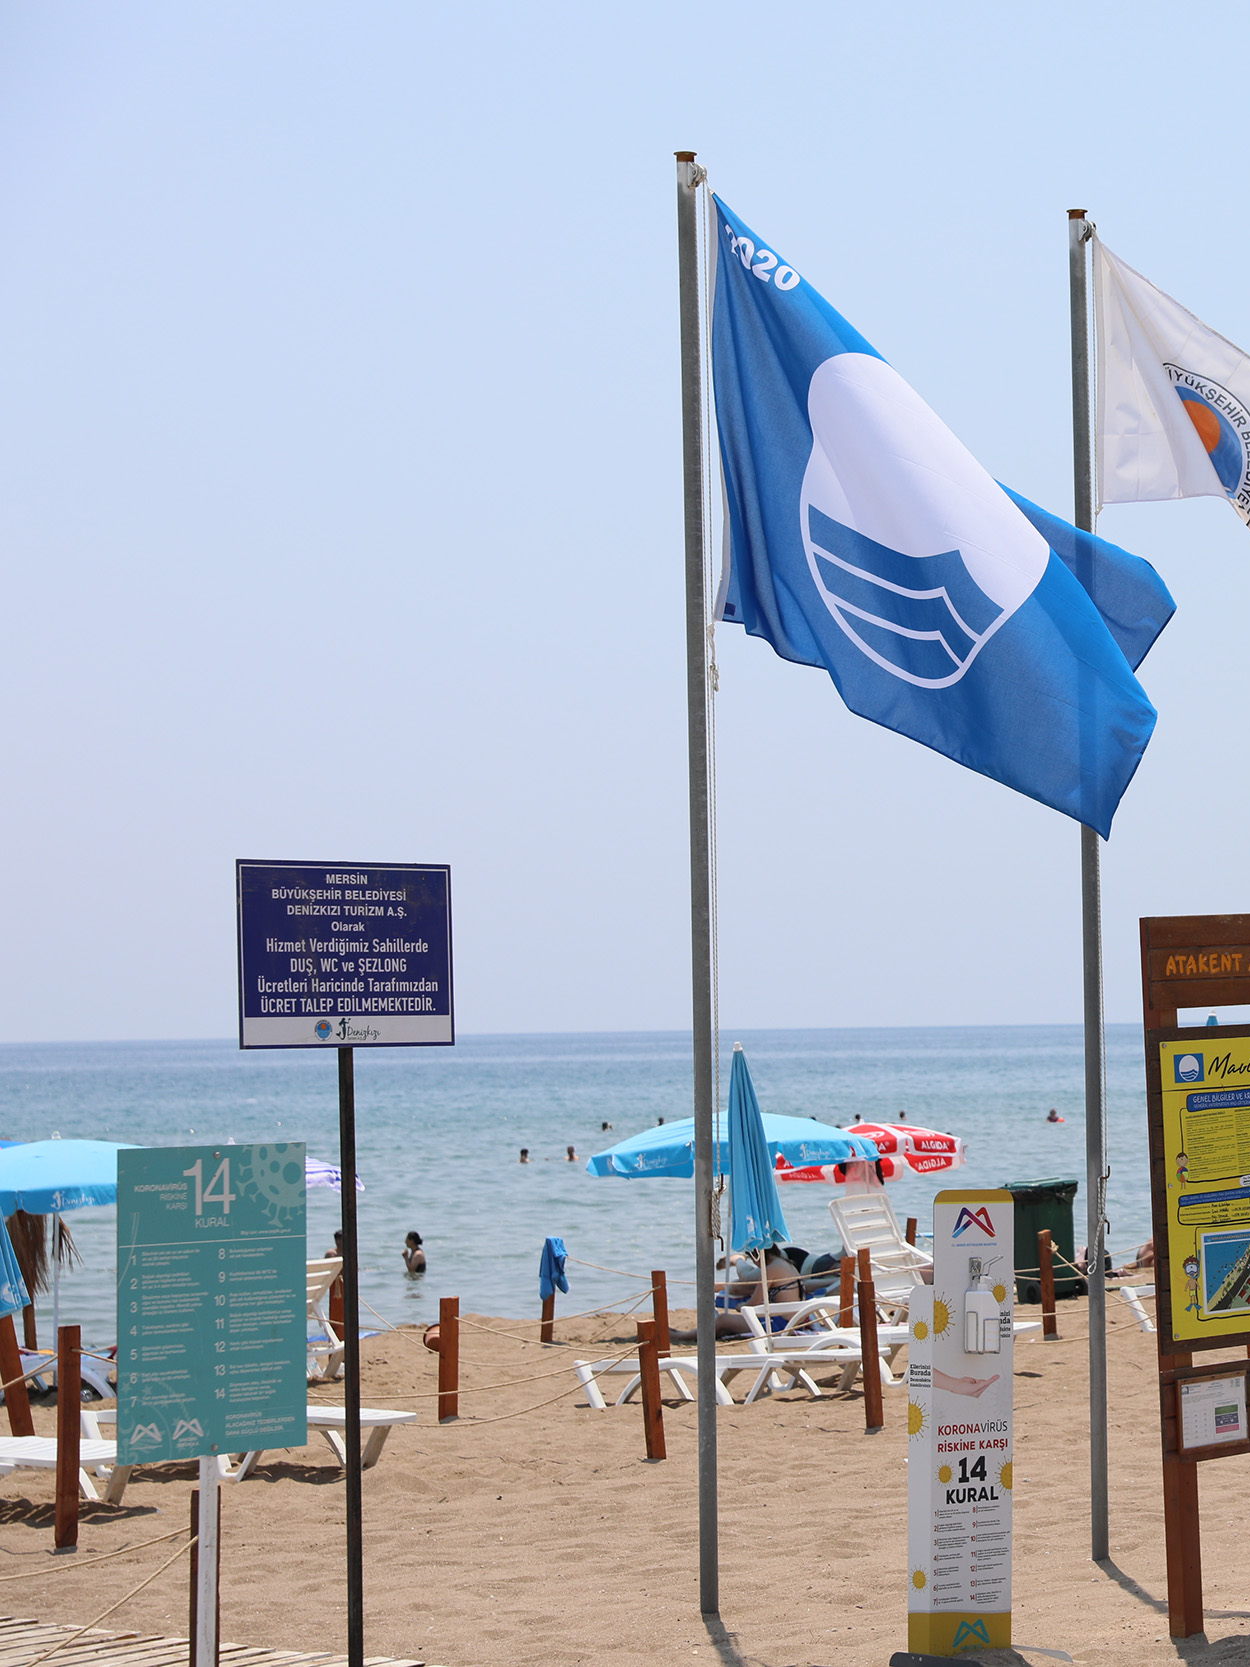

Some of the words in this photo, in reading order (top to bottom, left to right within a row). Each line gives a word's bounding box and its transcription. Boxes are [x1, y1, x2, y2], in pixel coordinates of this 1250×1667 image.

[326, 872, 368, 885] MERSİN
[272, 886, 342, 902] BÜYÜKŞEHİR
[345, 888, 406, 901] BELEDİYESİ
[287, 903, 341, 916] DENİZKIZI
[344, 903, 384, 916] TURİZM
[387, 907, 408, 919] A.Ş.
[331, 921, 365, 932] Olarak
[266, 938, 306, 953] Hizmet
[309, 938, 369, 955] Verdiğimiz
[372, 938, 428, 953] Sahillerde
[290, 958, 317, 975] DUŞ,
[320, 959, 339, 972] WC
[342, 962, 355, 972] ve
[358, 959, 407, 975] ŞEZLONG
[1166, 953, 1243, 976] ATAKENT
[257, 976, 308, 993] Ücretleri
[311, 978, 365, 992] Haricinde
[368, 977, 438, 992] Tarafımızdan
[261, 995, 297, 1013] ÜCRET
[300, 997, 334, 1013] TALEP
[337, 994, 436, 1012] EDİLMEMEKTEDİR.
[183, 1158, 236, 1216] 14
[195, 1217, 230, 1228] KURAL
[218, 1248, 226, 1260] 8
[130, 1255, 136, 1266] 1
[218, 1272, 226, 1282] 9
[130, 1278, 138, 1290] 2
[214, 1295, 226, 1306] 10
[130, 1302, 138, 1313] 3
[215, 1318, 224, 1329] 11
[130, 1325, 137, 1336] 4
[214, 1341, 226, 1352] 12
[130, 1349, 138, 1360] 5
[214, 1364, 226, 1376] 13
[130, 1373, 138, 1384] 6
[214, 1388, 226, 1399] 14
[130, 1396, 137, 1407] 7
[938, 1419, 1008, 1436] KORONAVİRÜS
[937, 1439, 976, 1453] RİSKİNE
[979, 1438, 1008, 1451] KARŞI
[958, 1456, 987, 1483] 14
[946, 1486, 999, 1505] KURAL
